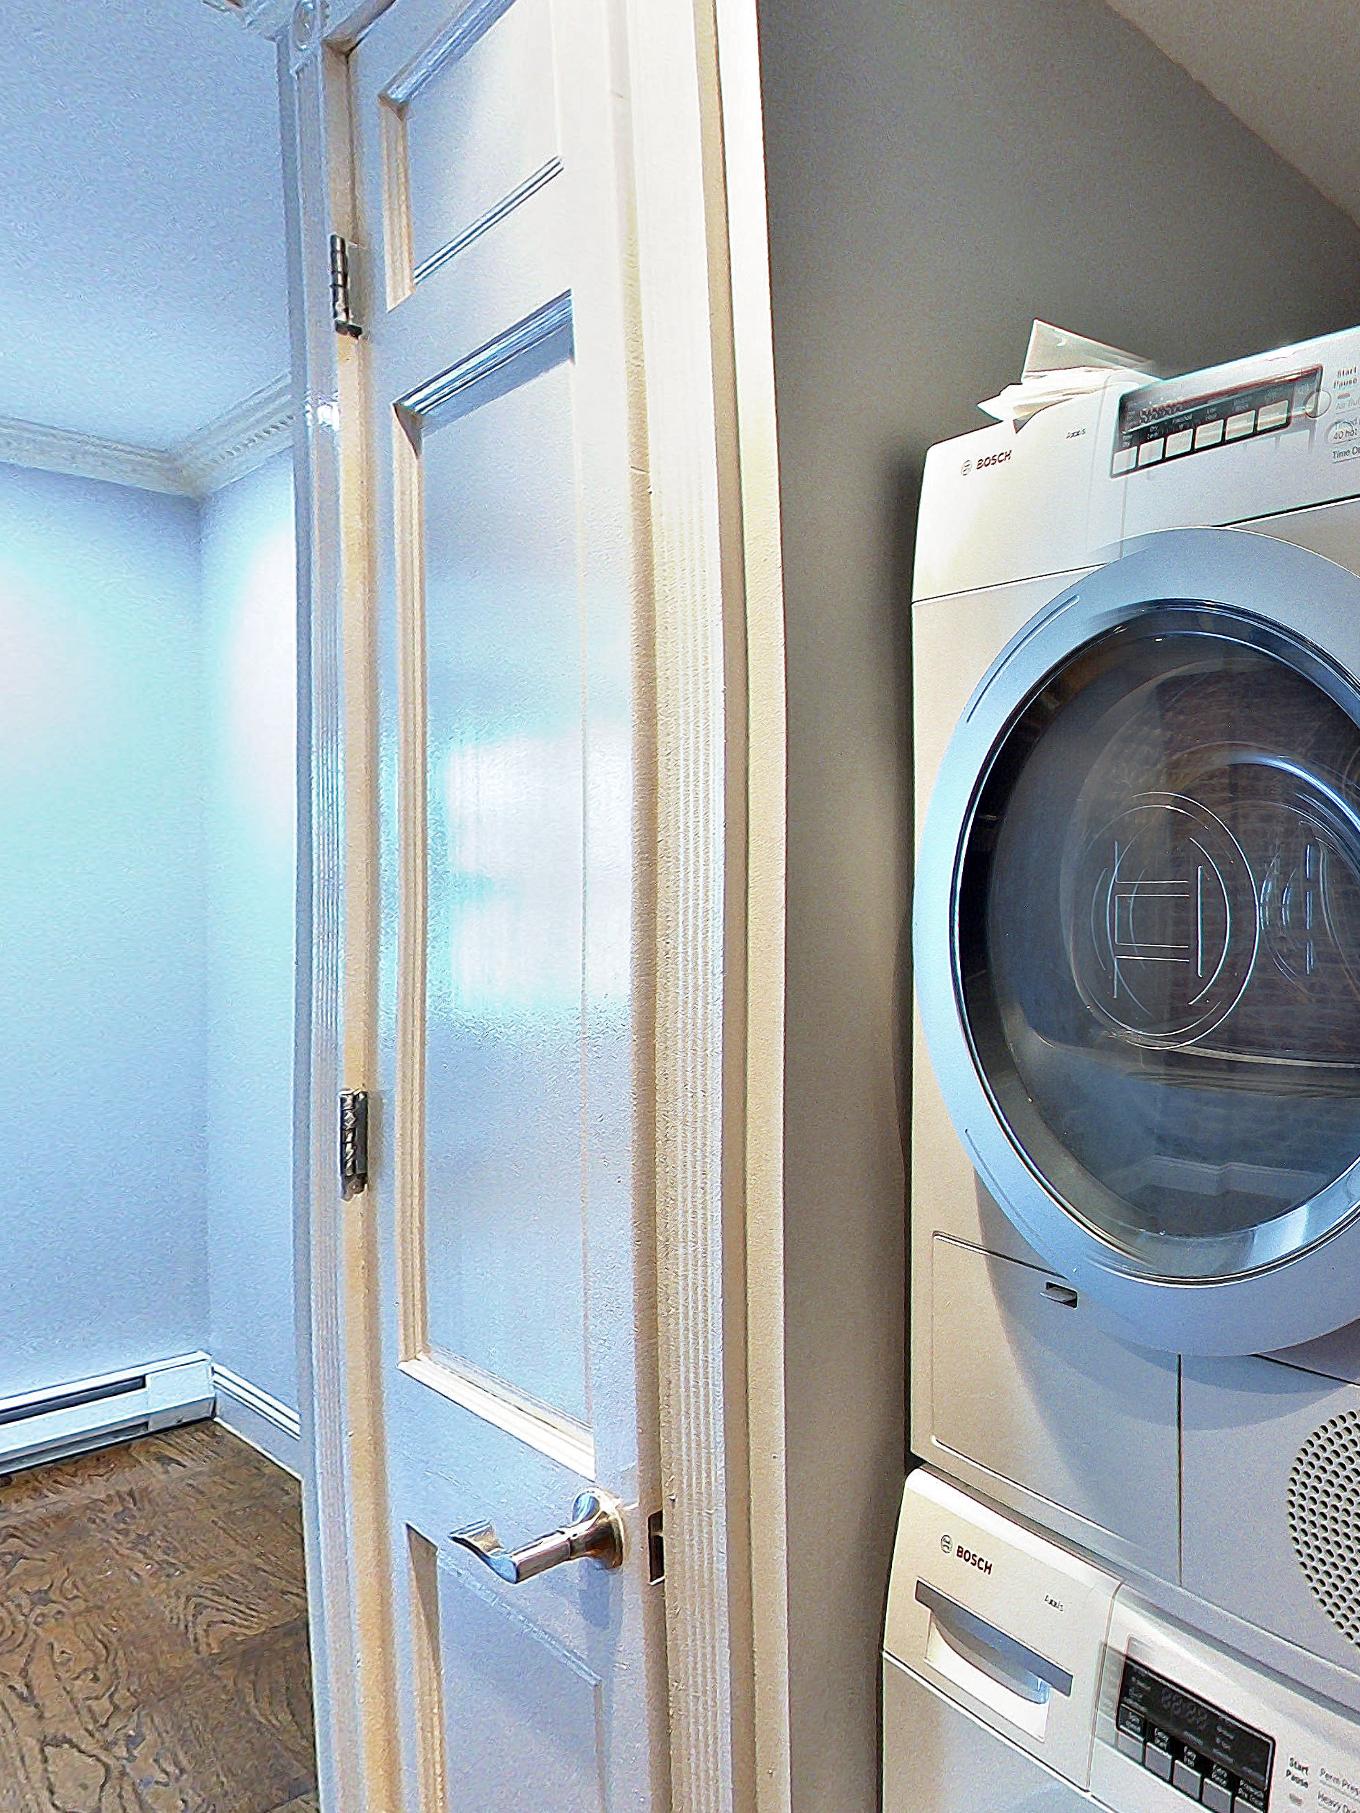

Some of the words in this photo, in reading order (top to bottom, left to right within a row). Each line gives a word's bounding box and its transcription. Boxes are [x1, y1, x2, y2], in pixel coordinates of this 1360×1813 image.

[1337, 366, 1358, 378] Start
[1333, 378, 1358, 389] Pause
[976, 450, 1012, 470] BOSCH
[1332, 447, 1351, 459] Time
[956, 1545, 993, 1575] BOSCH
[1289, 1757, 1309, 1776] Start
